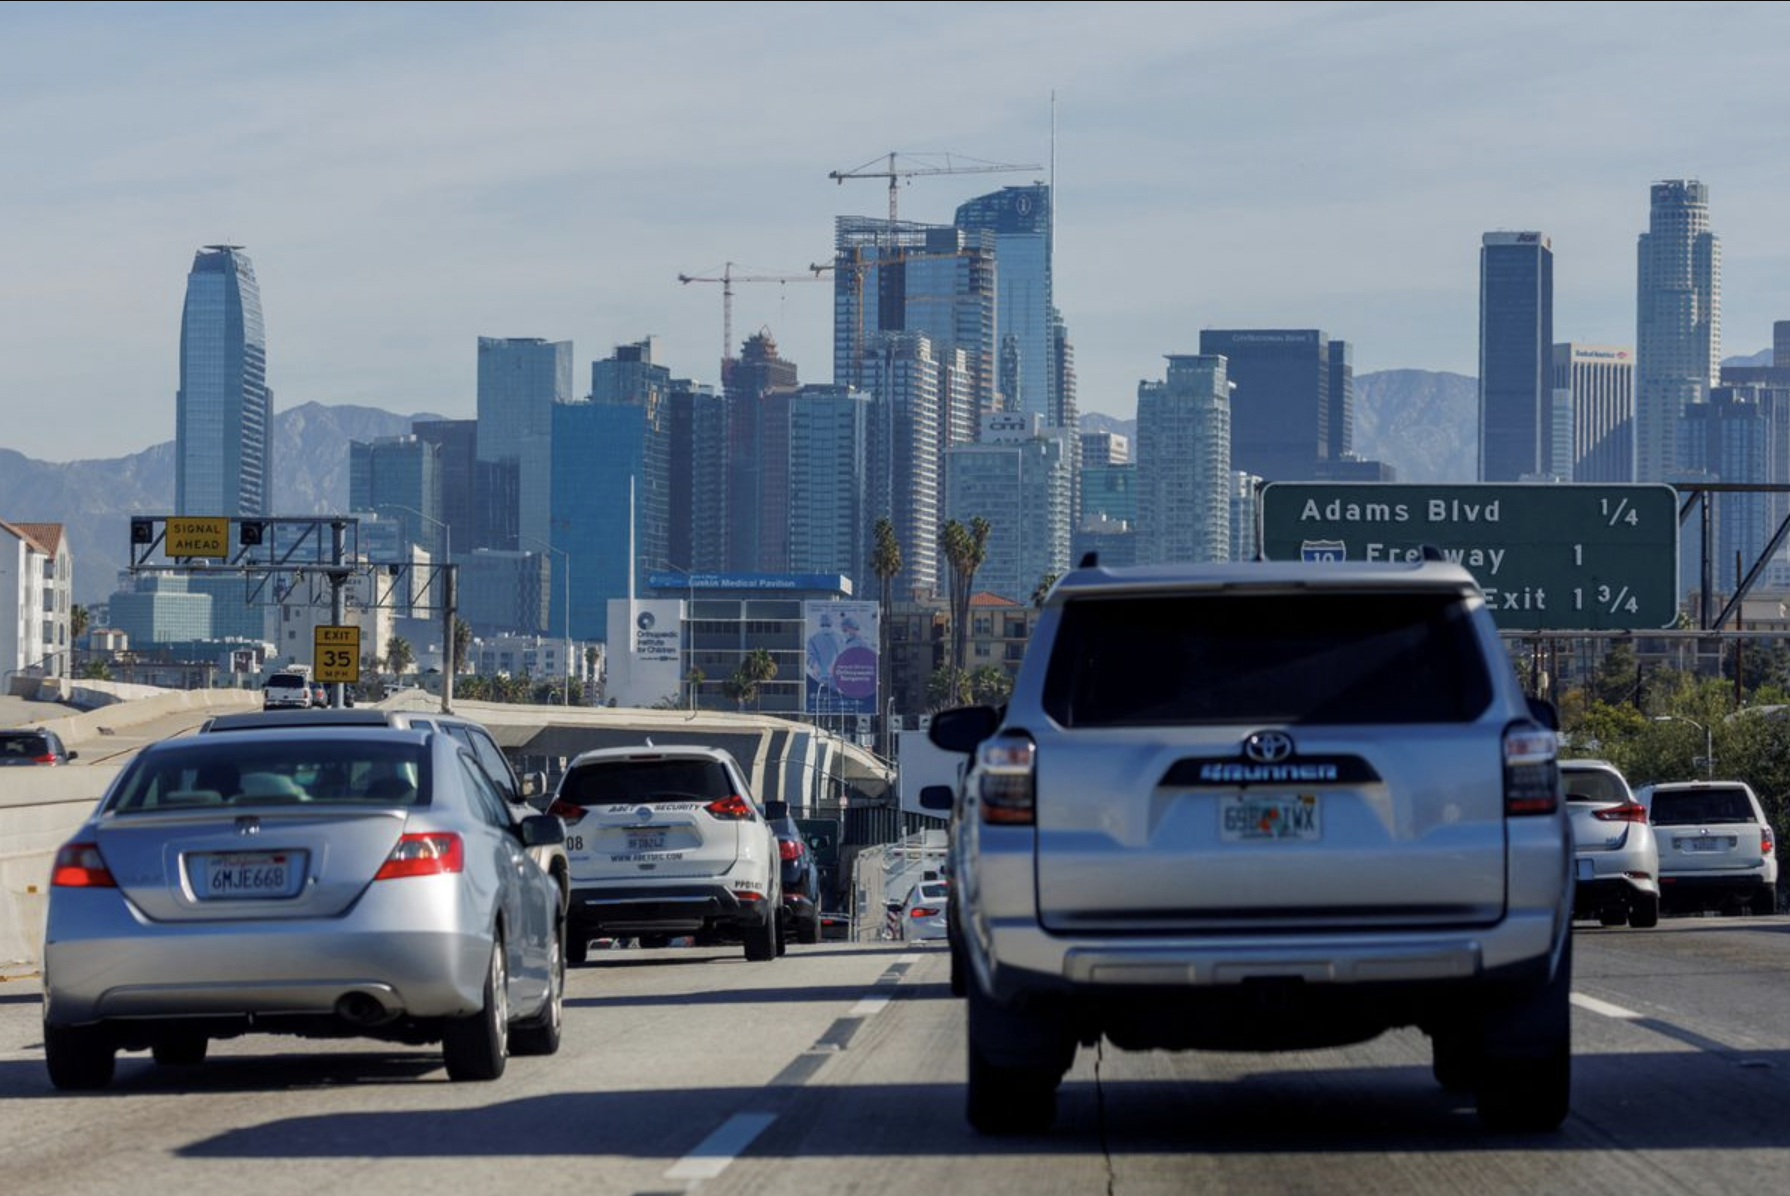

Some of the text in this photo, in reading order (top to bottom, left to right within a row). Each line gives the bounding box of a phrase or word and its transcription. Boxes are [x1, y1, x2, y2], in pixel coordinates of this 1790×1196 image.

[1301, 498, 1409, 521] Adams
[1428, 499, 1500, 521] Blvd
[174, 524, 221, 534] SIGNAL
[176, 540, 219, 549] AHEAD
[1367, 543, 1505, 574] Freway
[1573, 544, 1583, 566] 1
[721, 578, 757, 588] Medical
[759, 578, 795, 588] Pavilion
[1481, 587, 1546, 610] Exit
[1573, 588, 1583, 610] 1
[324, 631, 351, 640] EXIT
[324, 651, 351, 667] 35
[325, 670, 349, 678] MPH
[654, 803, 700, 811] SECURITY
